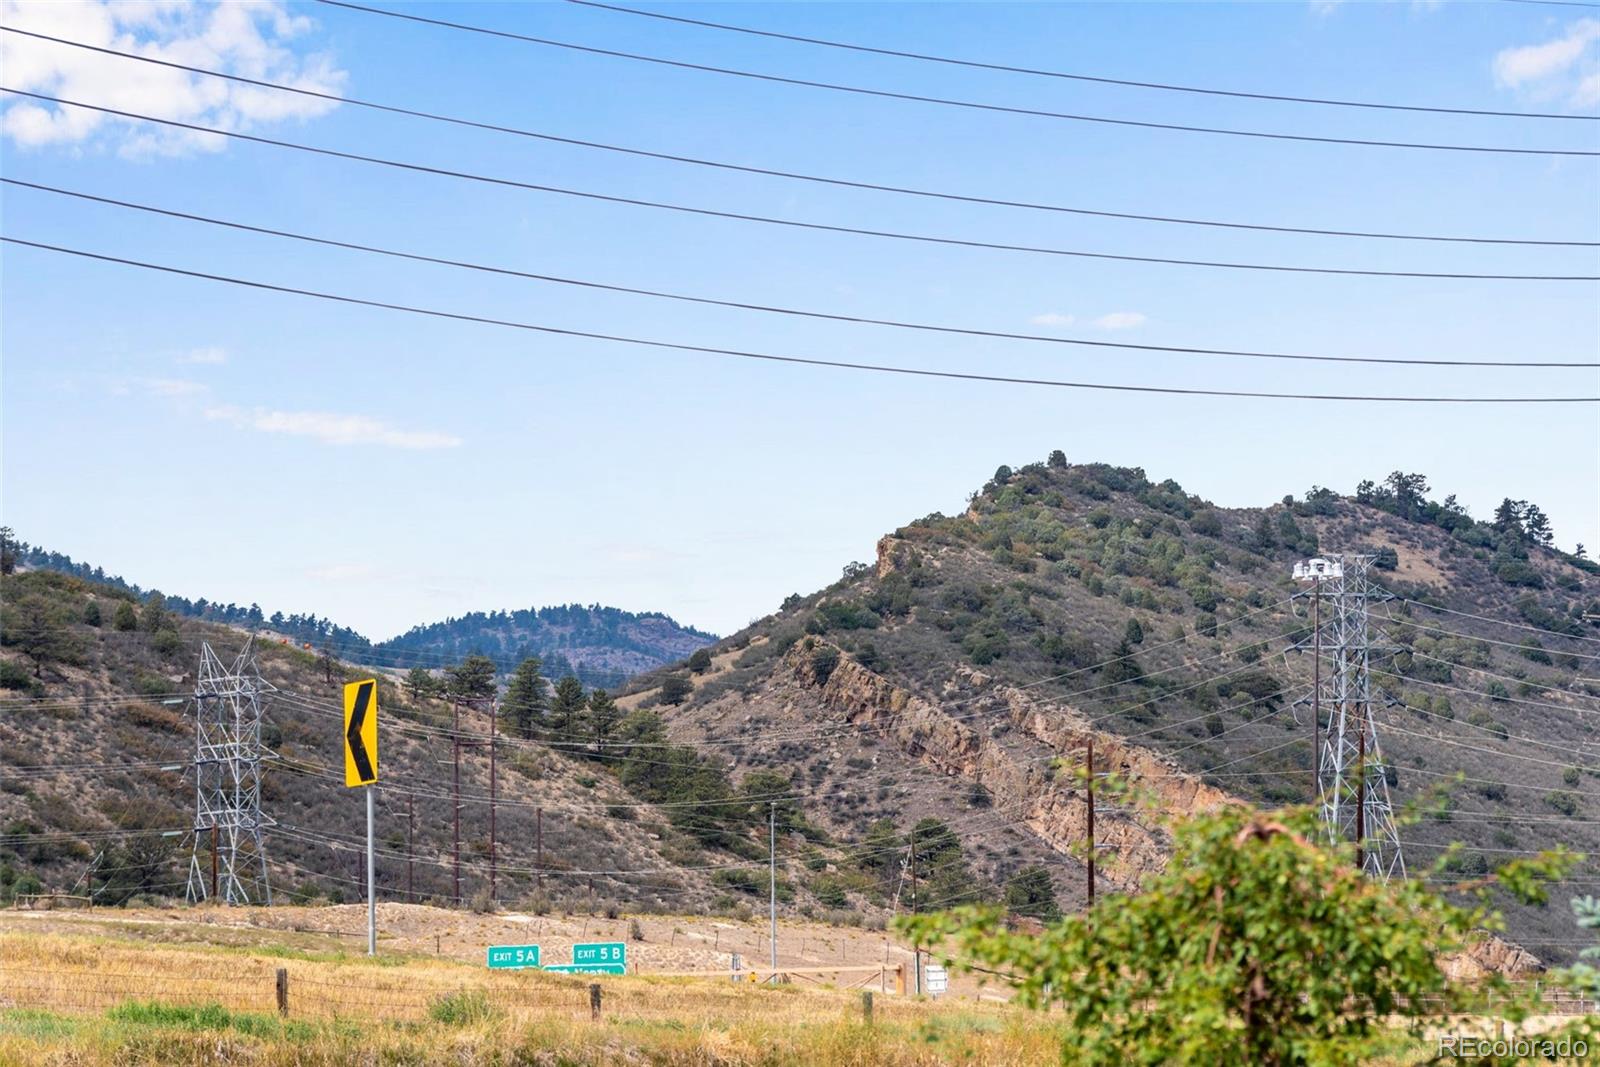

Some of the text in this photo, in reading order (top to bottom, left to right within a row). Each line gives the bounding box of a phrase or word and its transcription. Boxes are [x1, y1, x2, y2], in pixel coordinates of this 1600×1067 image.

[493, 952, 512, 962] EXIT
[577, 947, 621, 960] EXIT 5 B
